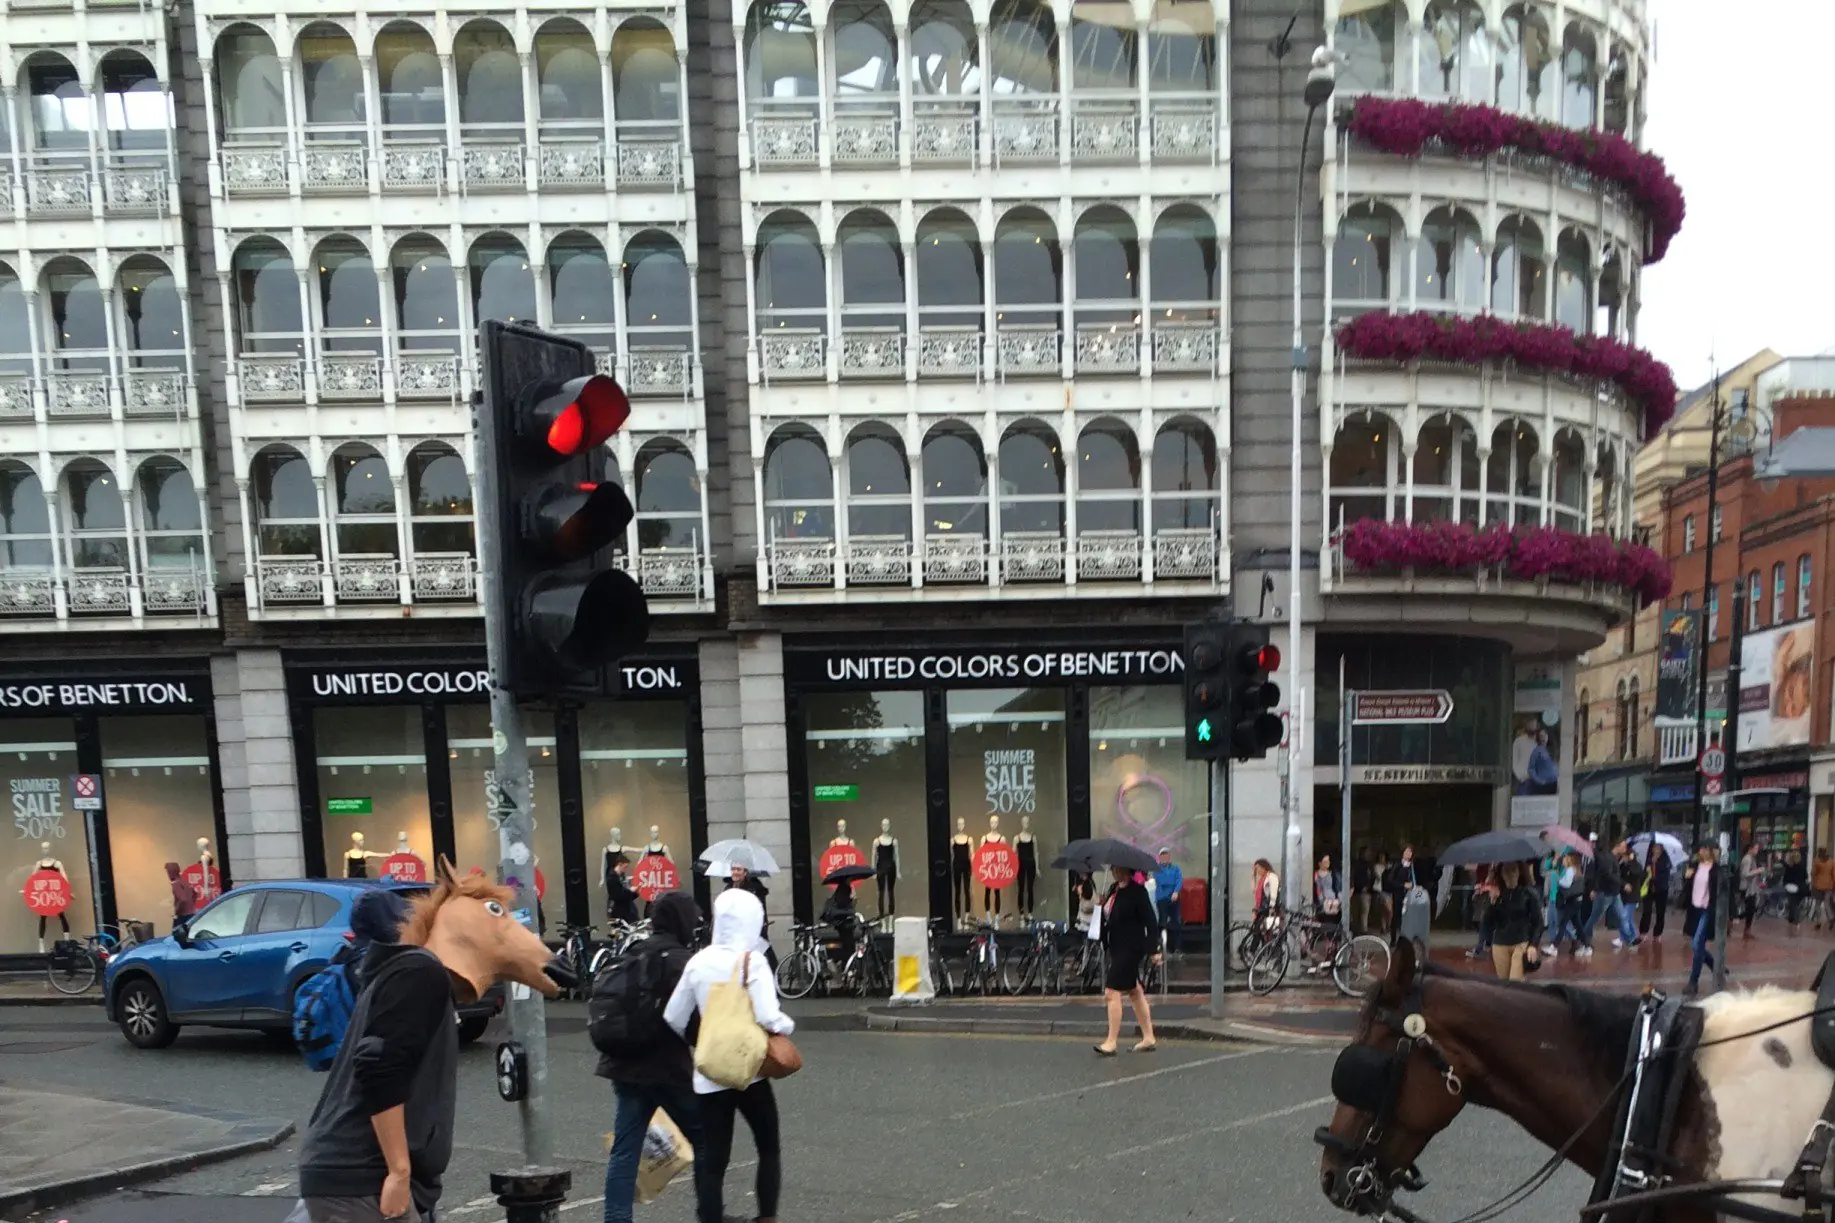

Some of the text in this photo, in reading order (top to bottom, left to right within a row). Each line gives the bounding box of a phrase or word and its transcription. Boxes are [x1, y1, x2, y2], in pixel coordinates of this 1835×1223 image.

[827, 656, 915, 680] UNITED
[919, 655, 1020, 678] COLORS
[1023, 653, 1057, 677] OF
[313, 671, 492, 695] UNITED COLOR
[621, 666, 682, 689] TON.
[22, 685, 55, 707] OF
[58, 683, 194, 706] BENETTON.
[984, 749, 1035, 766] SUMMER
[1706, 753, 1722, 768] 30
[9, 778, 61, 792] SUMMER
[985, 765, 1036, 791] SALE
[12, 792, 64, 818] SALE
[985, 790, 1036, 814] 50%
[14, 817, 67, 839] 50%
[829, 853, 856, 866] UP TO
[982, 851, 1008, 863] UP TO
[389, 862, 416, 874] UP TO
[979, 862, 1014, 881] 50%
[33, 879, 60, 890] UP TO
[638, 870, 674, 888] SALE
[30, 891, 66, 908] 50%
